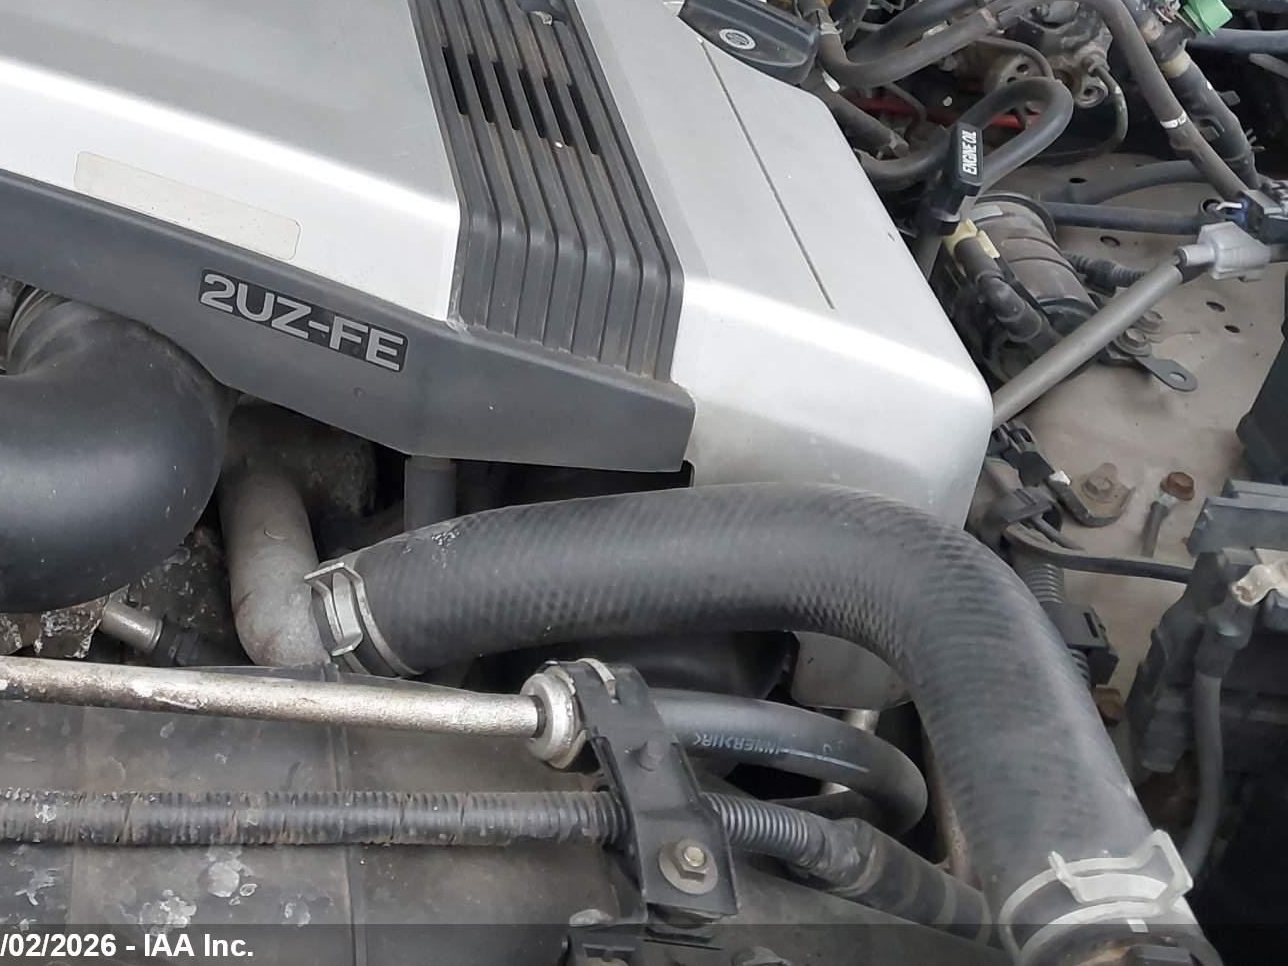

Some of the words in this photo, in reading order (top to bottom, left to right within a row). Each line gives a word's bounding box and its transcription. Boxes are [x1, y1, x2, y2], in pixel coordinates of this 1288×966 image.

[962, 129, 977, 144] OIL
[962, 141, 977, 175] ENGINE
[200, 273, 404, 371] 2UZ-FE
